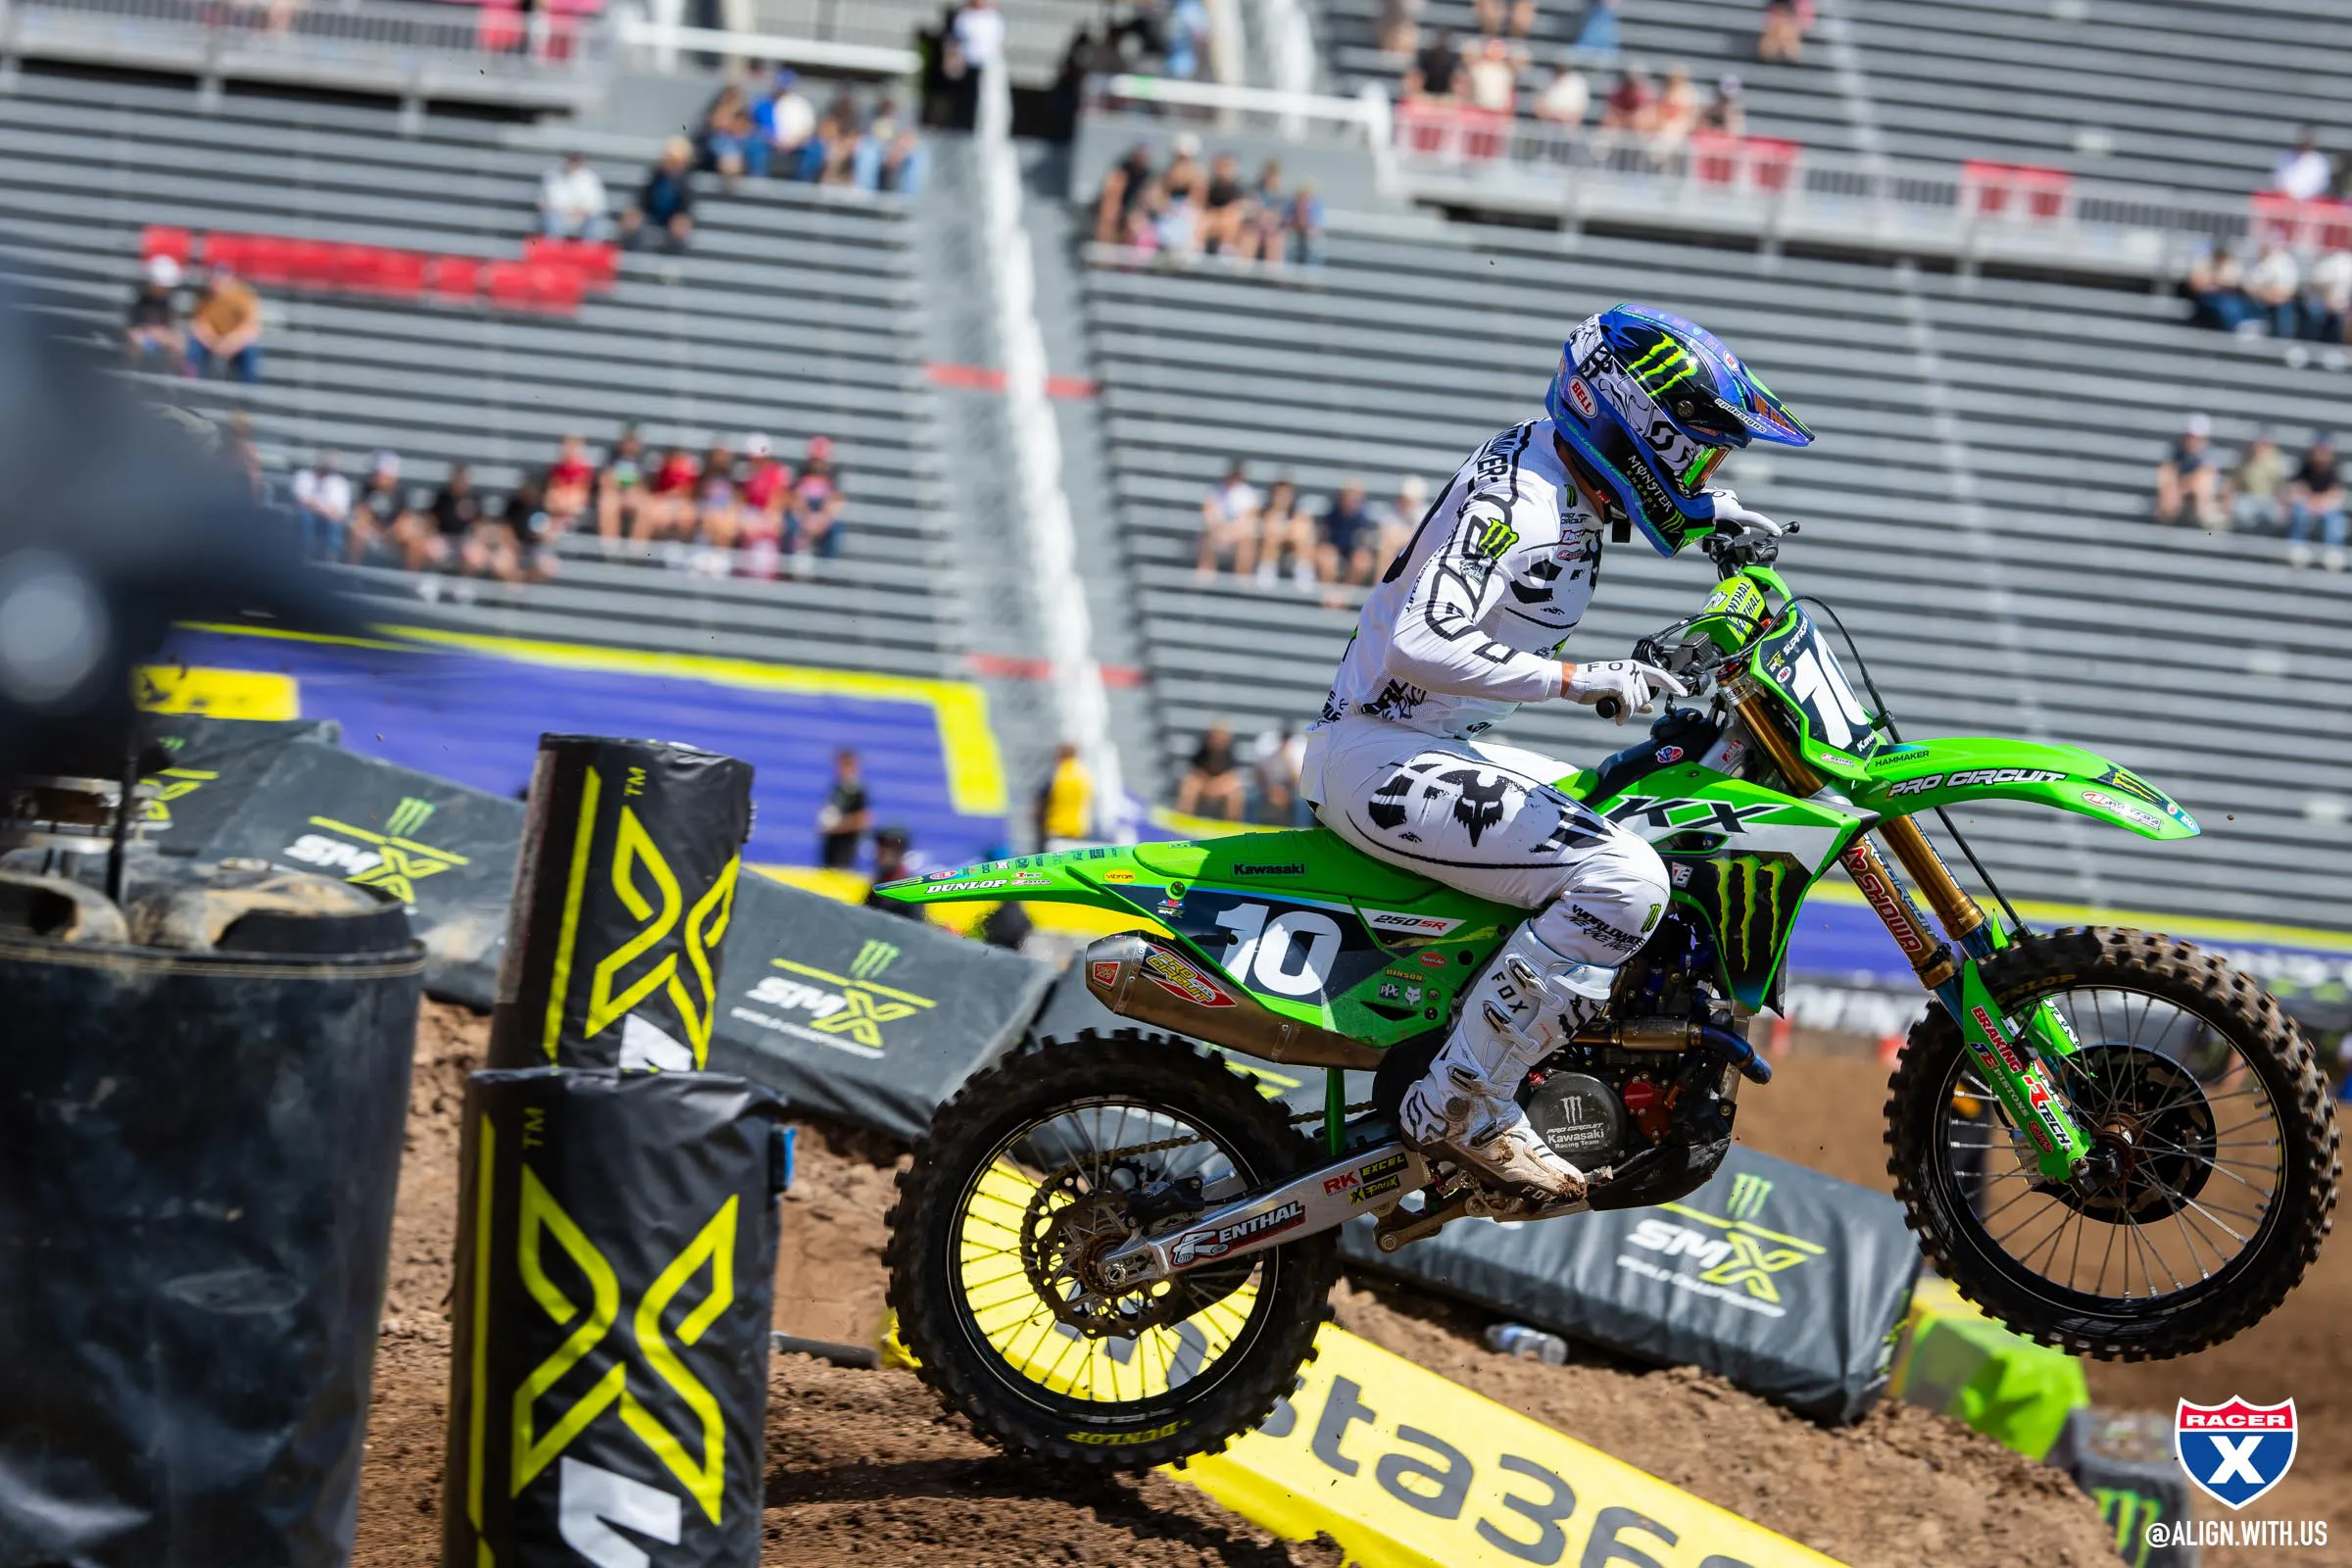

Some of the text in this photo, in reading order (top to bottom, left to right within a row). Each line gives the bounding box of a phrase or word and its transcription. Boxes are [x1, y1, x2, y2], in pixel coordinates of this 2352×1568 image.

[1571, 381, 1593, 414] BELL
[1714, 398, 1767, 432] apdesigns
[1628, 455, 1674, 513] MONSTER
[1587, 662, 1641, 684] FOX
[1875, 750, 1930, 767] HAMMAKER
[1887, 767, 2070, 799] PRO CIRCUIT
[1601, 795, 1792, 834] KX
[1233, 863, 1305, 875] Kawasaki
[924, 878, 1009, 895] DUNLOP
[1373, 914, 1448, 931] 250SR
[1856, 872, 1923, 953] SHOWA
[1215, 903, 1343, 996] 10
[1148, 956, 1212, 1003] CIRCUIT
[1159, 954, 1197, 979] PRO
[1380, 983, 1399, 997] PPG
[1491, 971, 1530, 1013] FOX
[745, 976, 918, 1049] SMX
[1971, 1004, 2023, 1074] BRAKING
[1969, 1042, 2000, 1069] JE
[1992, 1067, 2030, 1118] PISTONS
[523, 1106, 546, 1150] TM
[1547, 1128, 1605, 1145] Kawasaki
[1567, 1122, 1604, 1132] CIRCUIT
[1554, 1141, 1580, 1150] Racing
[1362, 1155, 1405, 1177] EXCEL
[1323, 1171, 1360, 1194] RK
[1520, 1185, 1558, 1202] FOX
[1626, 1218, 1809, 1302] SMX
